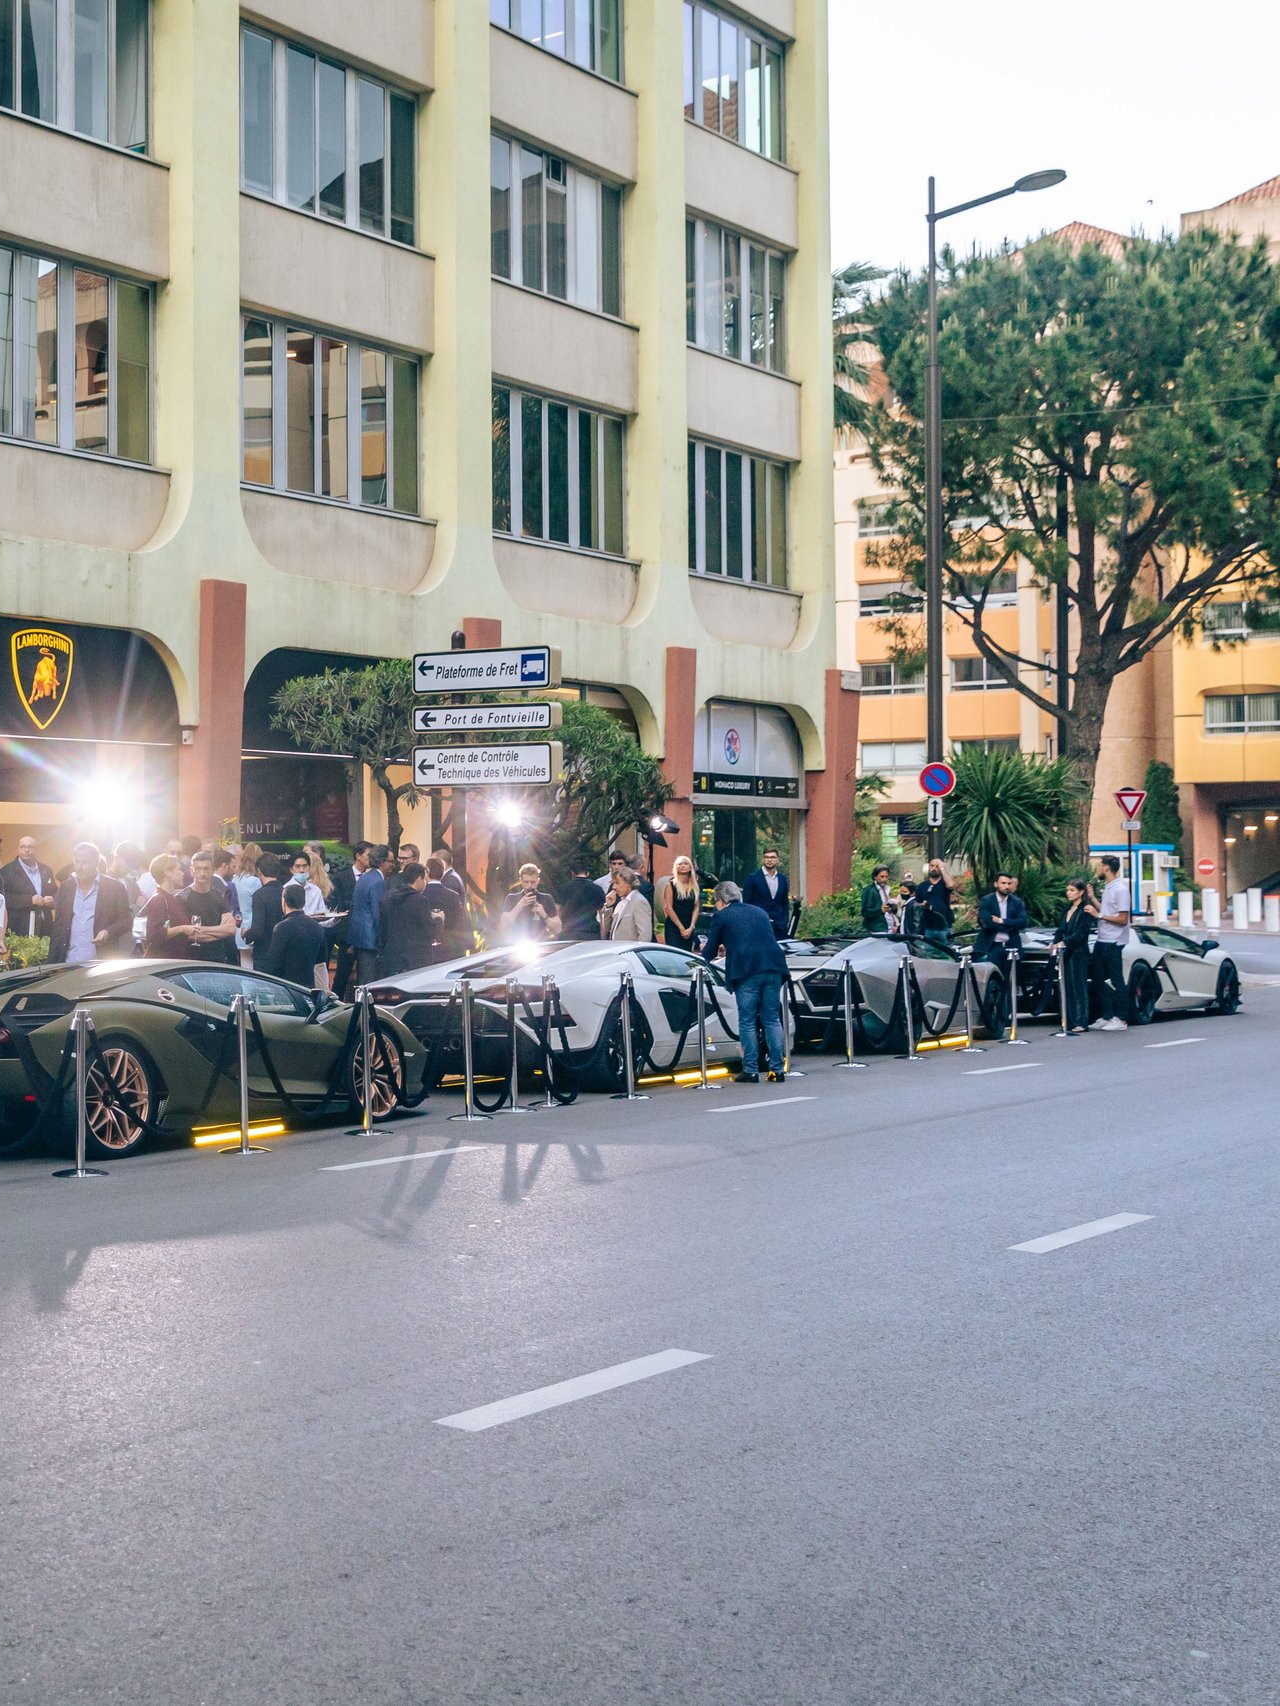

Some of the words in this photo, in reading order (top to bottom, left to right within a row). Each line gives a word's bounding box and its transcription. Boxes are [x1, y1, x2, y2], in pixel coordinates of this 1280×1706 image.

[16, 633, 69, 655] LAMBORGHINI
[435, 664, 483, 680] Plateforme
[485, 663, 497, 677] de
[499, 662, 519, 676] Fret
[444, 713, 467, 725] Port
[471, 713, 483, 724] de
[487, 711, 545, 724] Fontvieille
[437, 752, 466, 764] Centre
[467, 751, 479, 763] de
[480, 750, 519, 763] Contrôle
[437, 767, 482, 781] Technique
[483, 766, 500, 778] des
[502, 765, 546, 778] Véhicules
